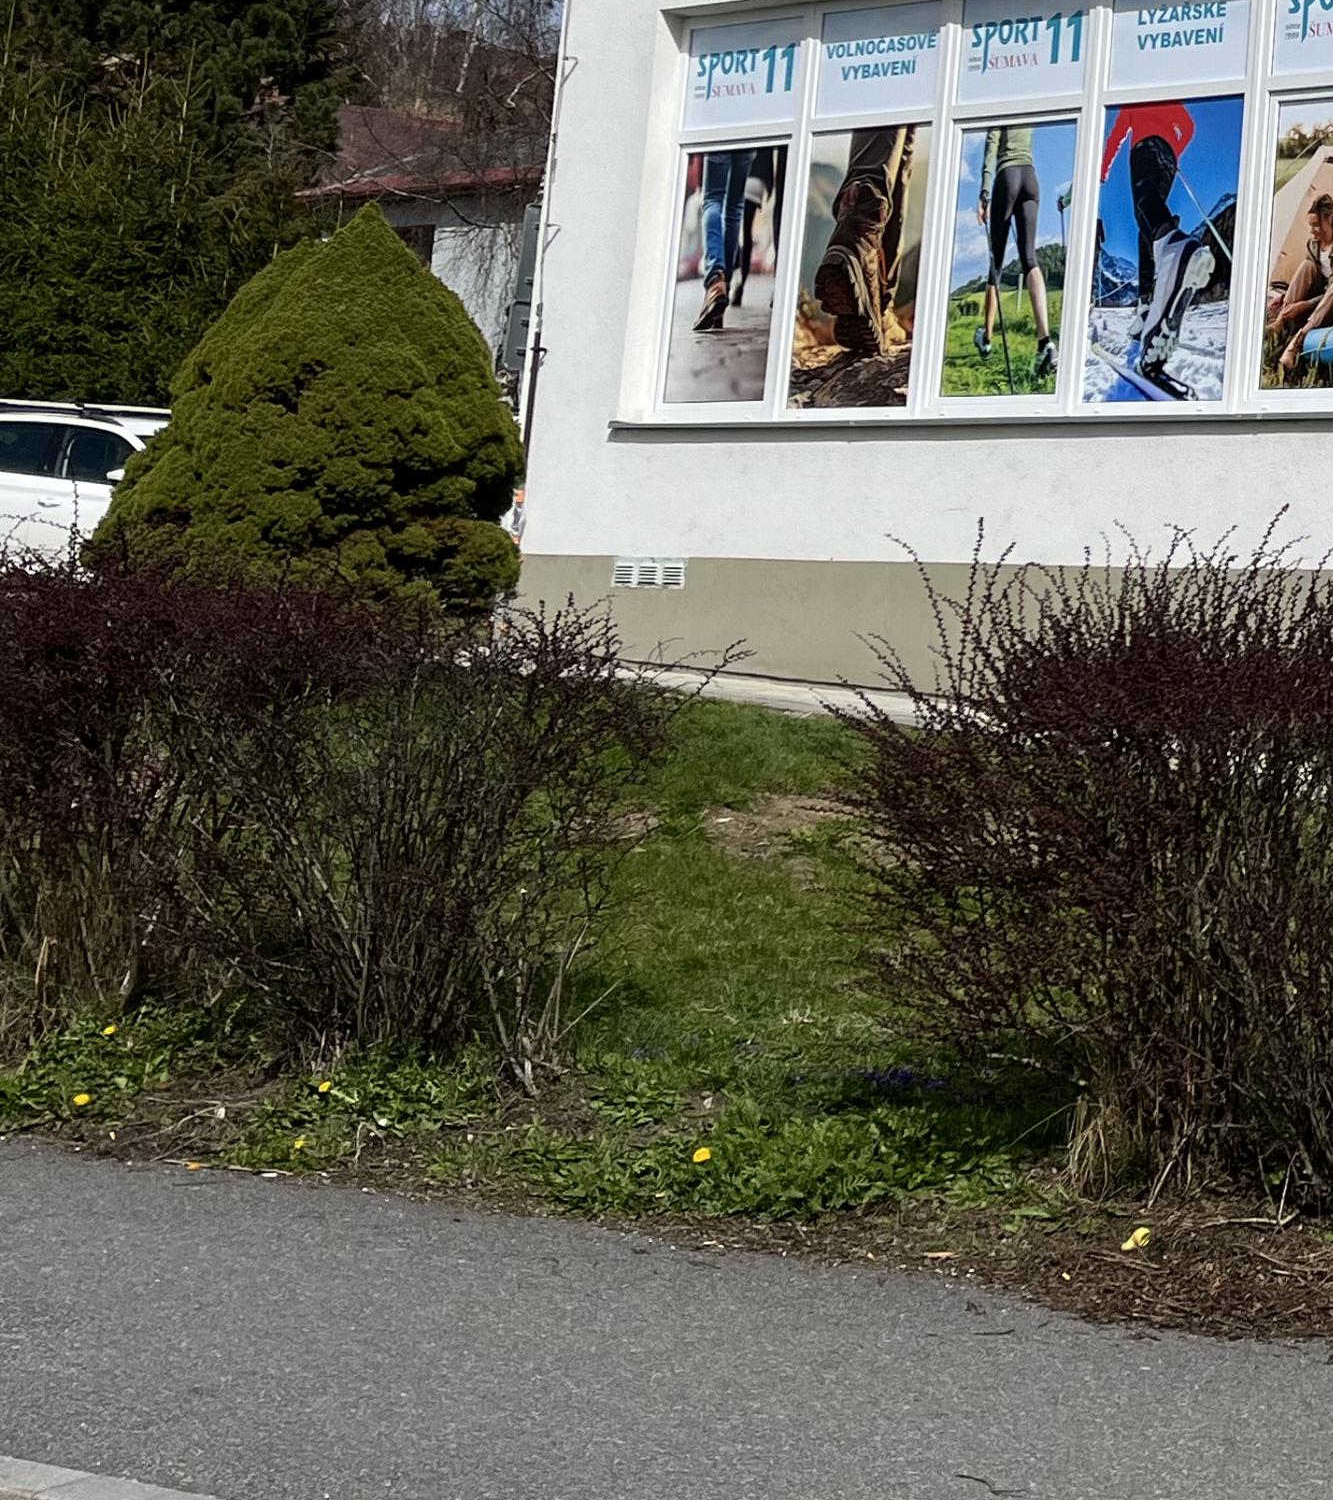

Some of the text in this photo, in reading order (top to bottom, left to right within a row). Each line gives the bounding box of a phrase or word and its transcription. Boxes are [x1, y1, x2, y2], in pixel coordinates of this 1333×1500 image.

[826, 31, 937, 59] VOLNOČASOVÉ
[971, 10, 1084, 75] SPORT 11
[1138, 24, 1225, 51] VYBAVENÍ
[697, 42, 796, 100] SPORT 11
[841, 56, 917, 81] VYBAVENÍ
